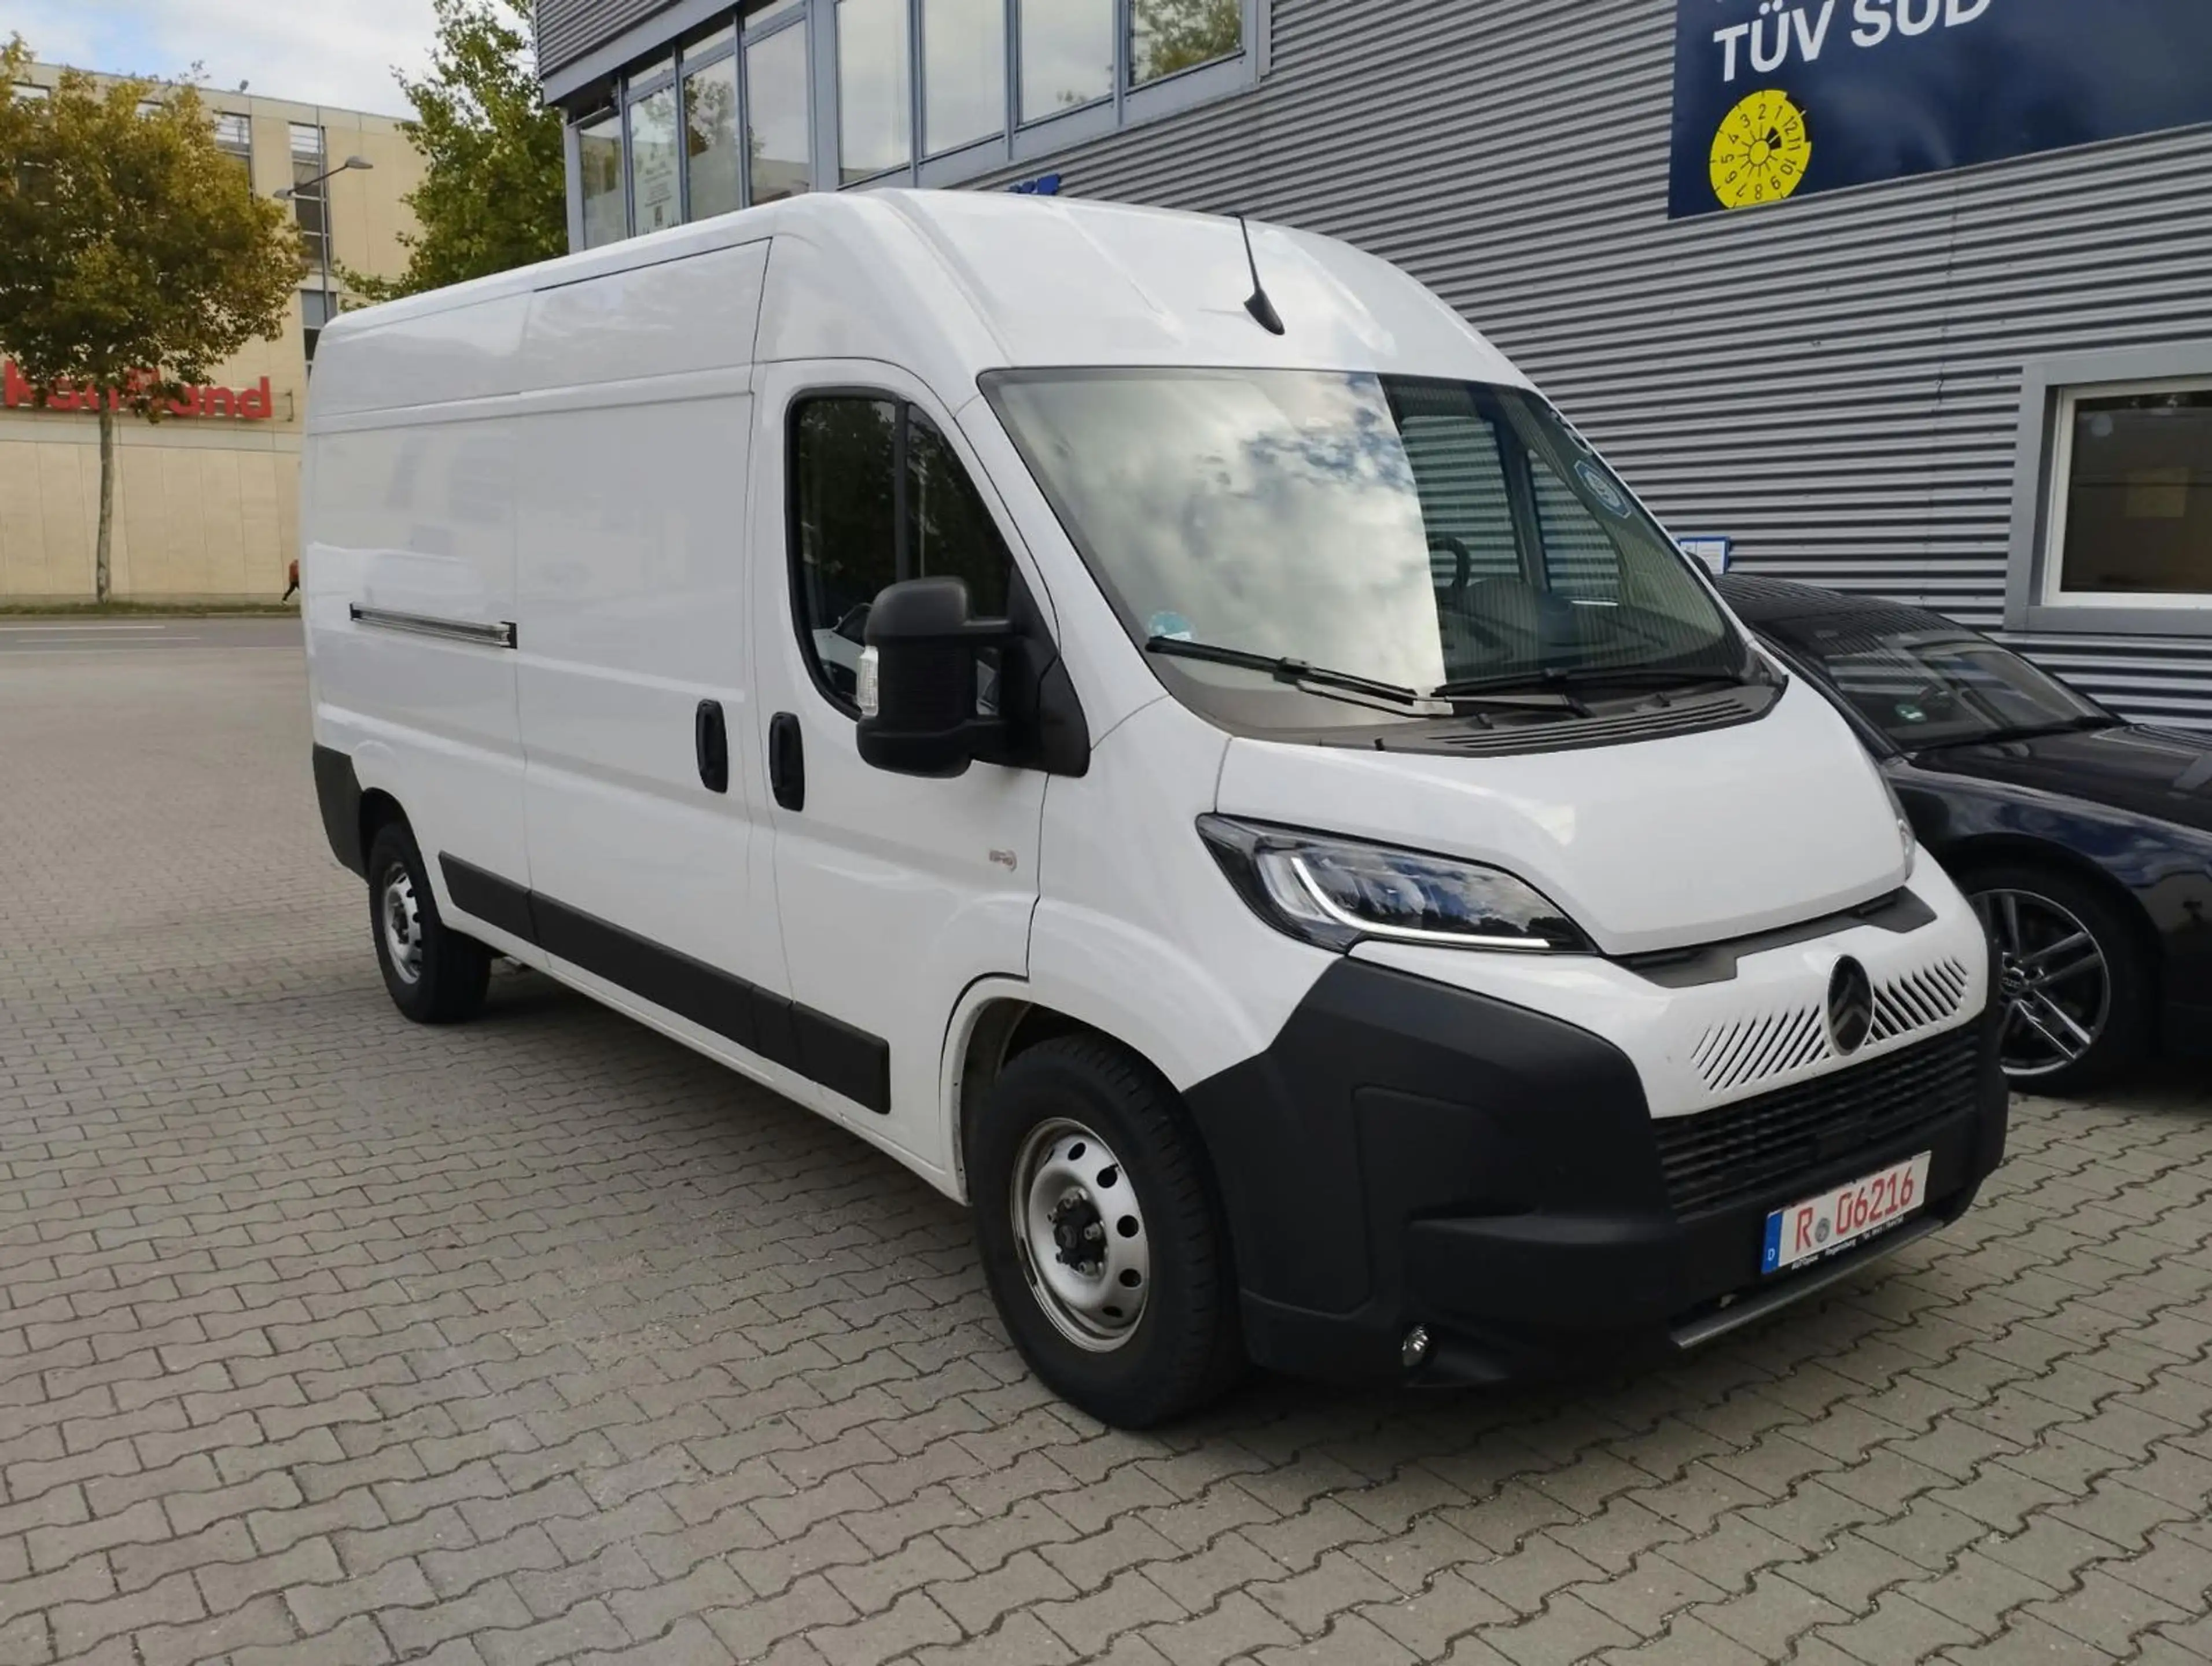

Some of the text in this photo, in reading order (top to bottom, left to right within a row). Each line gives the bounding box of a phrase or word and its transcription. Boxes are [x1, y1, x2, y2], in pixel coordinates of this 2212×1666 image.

[1713, 0, 1836, 82] TÜV
[1758, 104, 1766, 120] 2
[1775, 106, 1783, 120] 1
[1740, 113, 1750, 128] 3
[1782, 116, 1798, 135] 12
[1728, 132, 1739, 144] 4
[1787, 138, 1801, 150] 11
[1721, 154, 1735, 164] 5
[1780, 158, 1797, 175] 10
[1725, 171, 1738, 184] 6
[1771, 175, 1781, 190] 9
[1736, 183, 1747, 197] 7
[1755, 184, 1763, 200] 8
[5, 361, 272, 420] Kauand
[1795, 1207, 1813, 1253] R
[1835, 1165, 1915, 1236] 06216
[1768, 1248, 1775, 1261] D
